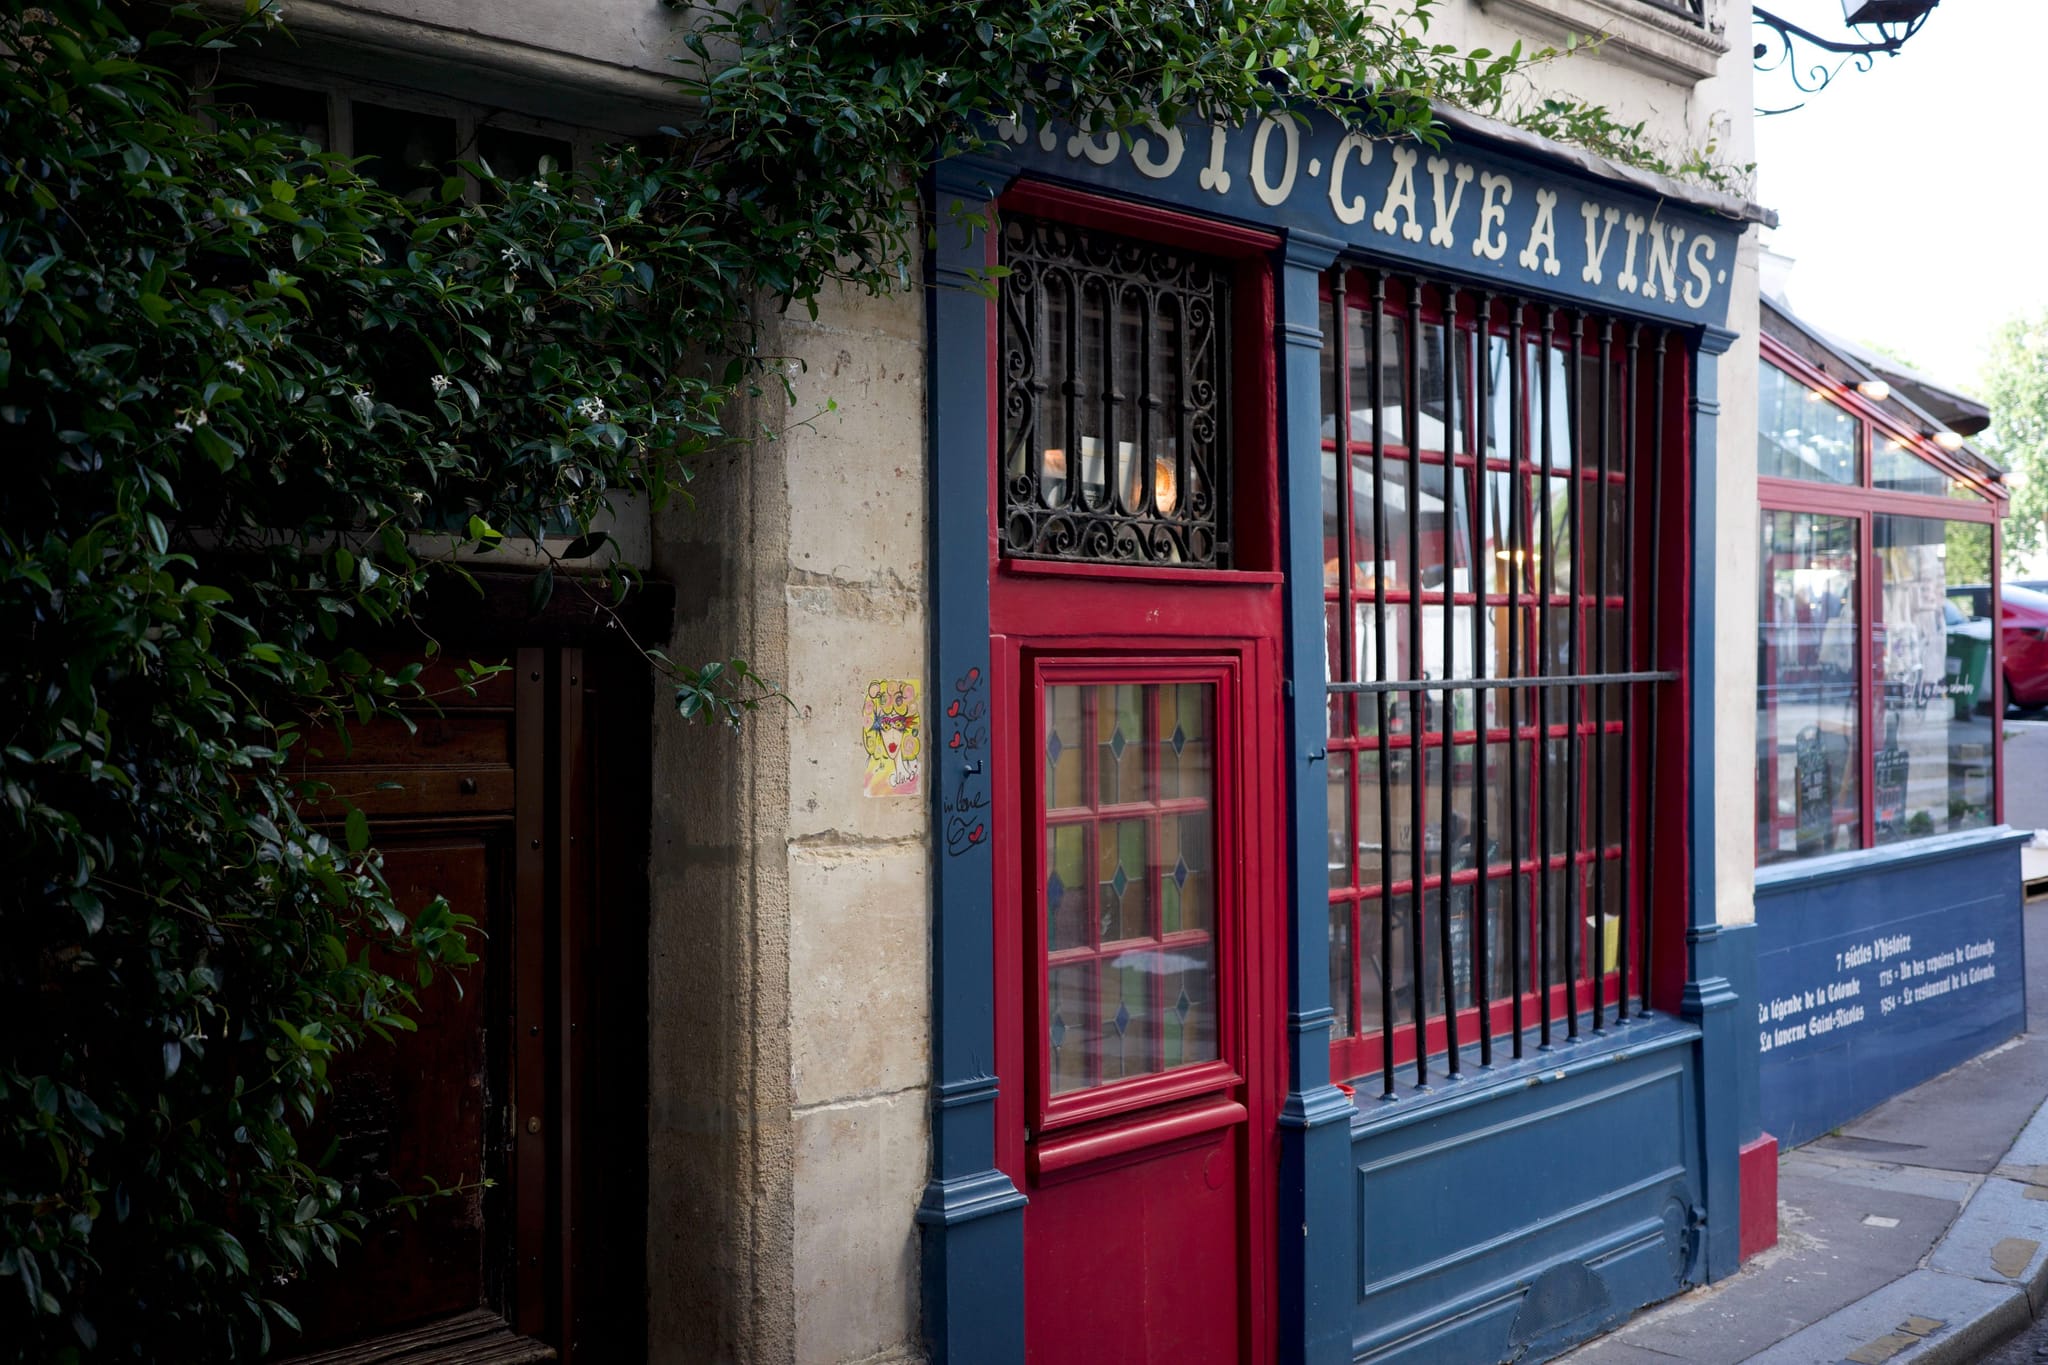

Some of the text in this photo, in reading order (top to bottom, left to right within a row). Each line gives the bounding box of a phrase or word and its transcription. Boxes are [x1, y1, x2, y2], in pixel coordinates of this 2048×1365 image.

[1836, 952, 1842, 973] 7
[1770, 993, 1803, 1022] légende
[1804, 990, 1815, 1010] de
[1816, 986, 1826, 1007] la
[1827, 976, 1861, 1003] Colombe
[1774, 1023, 1807, 1049] taverne
